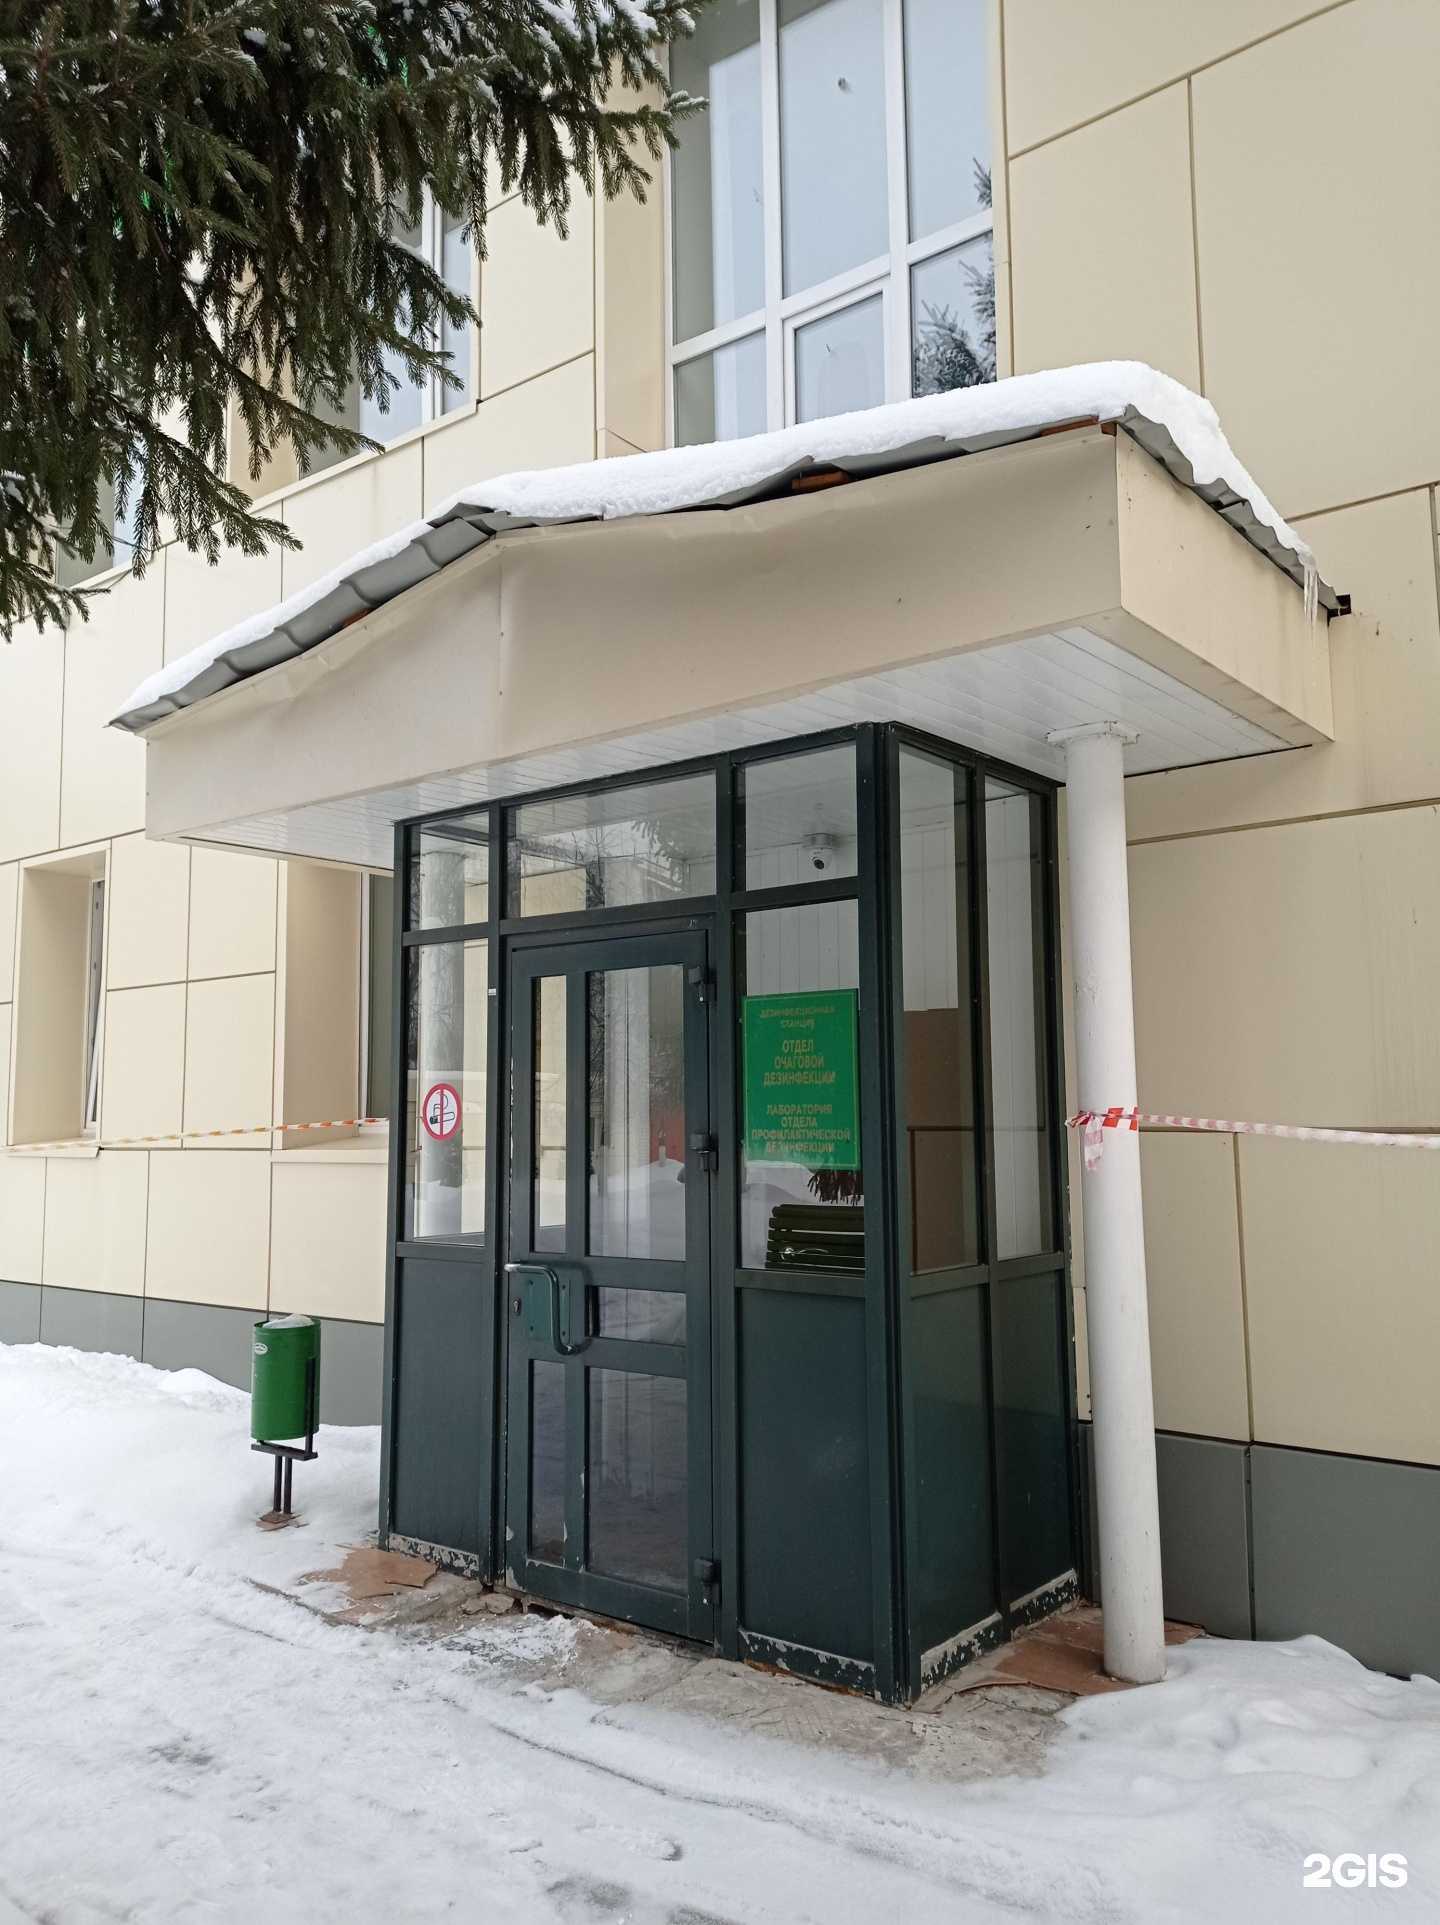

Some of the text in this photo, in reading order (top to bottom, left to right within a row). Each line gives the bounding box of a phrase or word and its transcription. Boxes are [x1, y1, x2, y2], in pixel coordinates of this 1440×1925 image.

[782, 1040, 814, 1055] ОТДЕЛ
[764, 1072, 836, 1087] ДЕЗИНФЕКЦИИ
[767, 1104, 832, 1115] ЛАБОРАТОРИЯ
[781, 1116, 817, 1128] ОТДЕЛА
